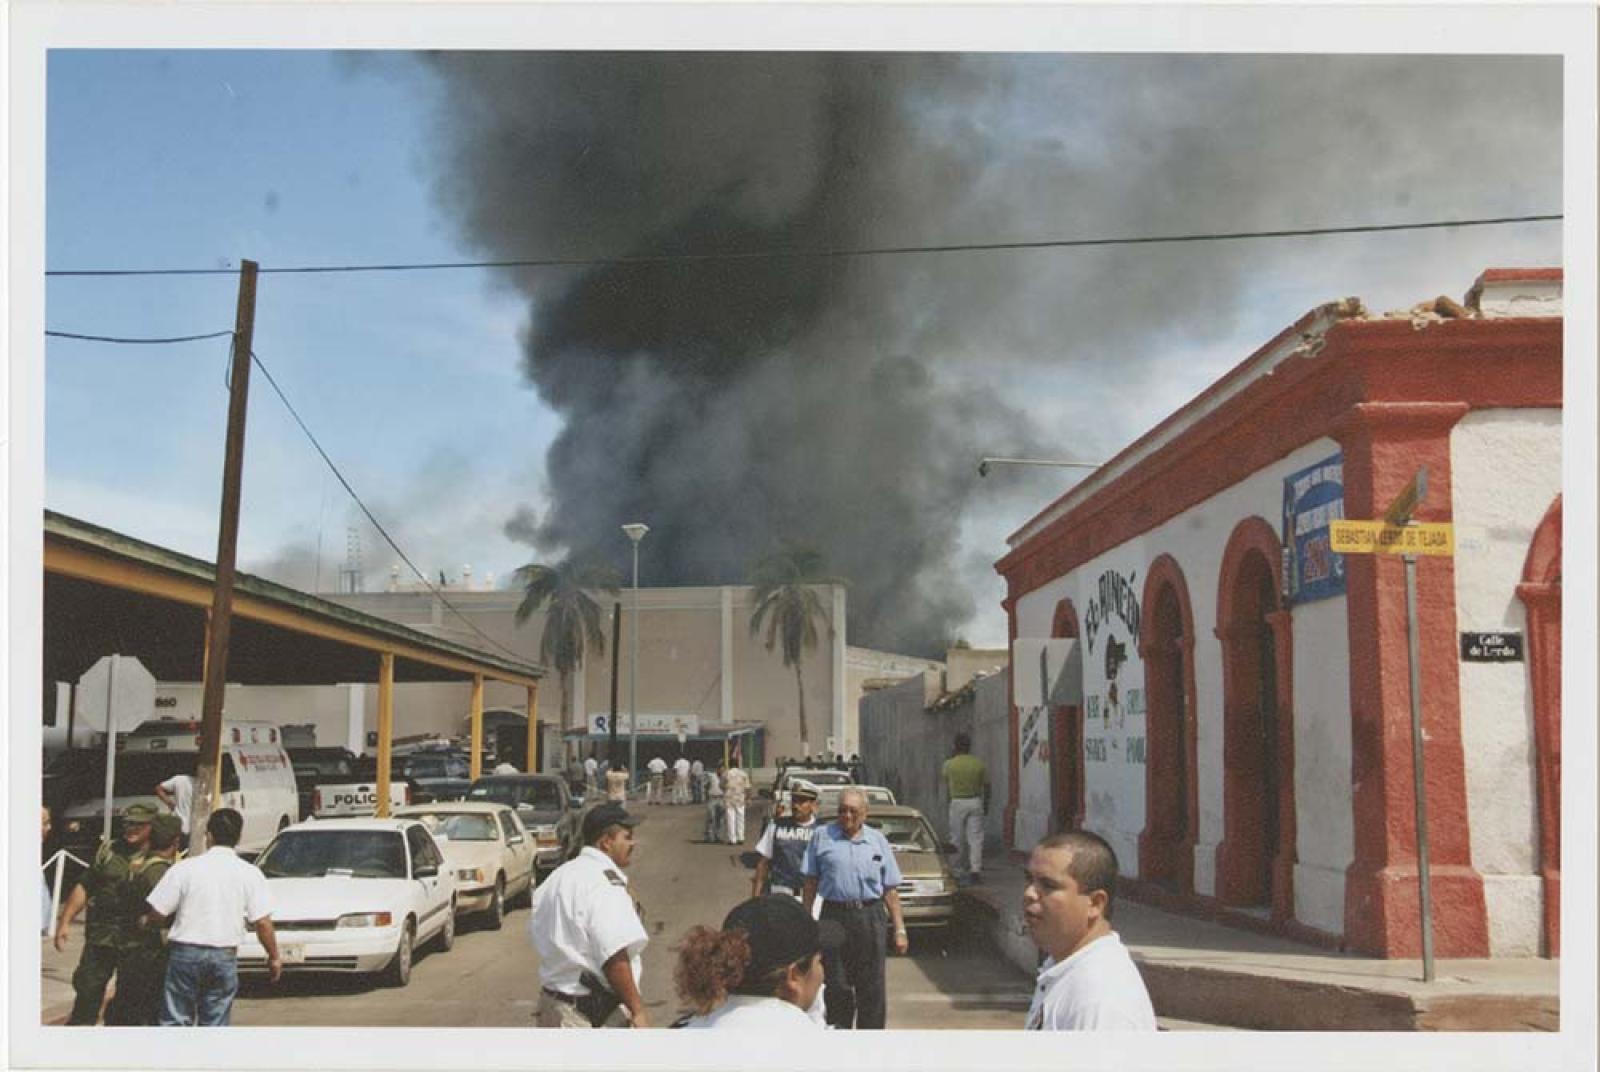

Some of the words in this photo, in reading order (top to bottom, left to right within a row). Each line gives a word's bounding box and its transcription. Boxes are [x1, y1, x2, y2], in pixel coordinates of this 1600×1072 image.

[1419, 530, 1448, 548] TEJADA
[1479, 634, 1505, 646] Calle
[1469, 645, 1482, 657] de
[334, 793, 392, 804] POLIC
